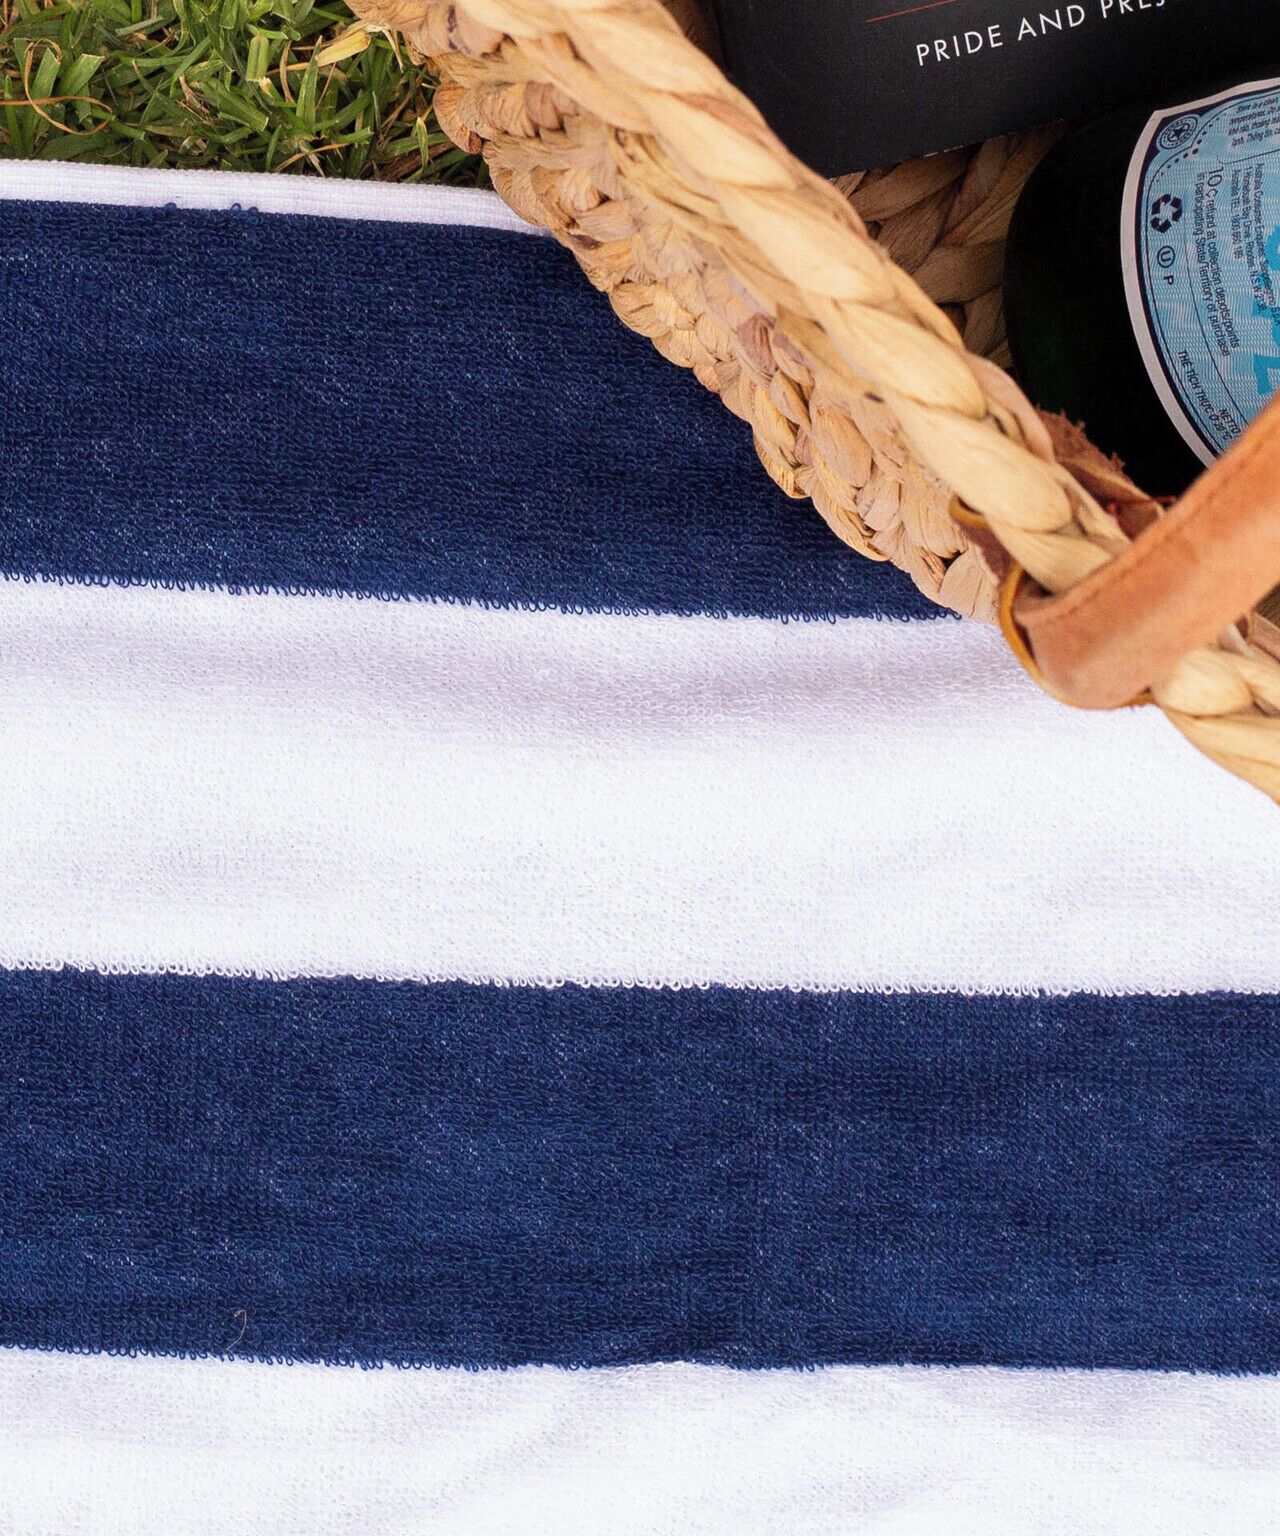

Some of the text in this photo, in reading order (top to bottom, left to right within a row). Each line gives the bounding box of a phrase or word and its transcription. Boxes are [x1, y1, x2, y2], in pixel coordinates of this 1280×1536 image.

[916, 24, 1003, 66] PRIDE
[1017, 4, 1086, 41] AND
[1206, 200, 1215, 229] refund
[1208, 242, 1221, 284] collection
[1210, 313, 1230, 356] purchase
[1215, 284, 1240, 348] depots/points
